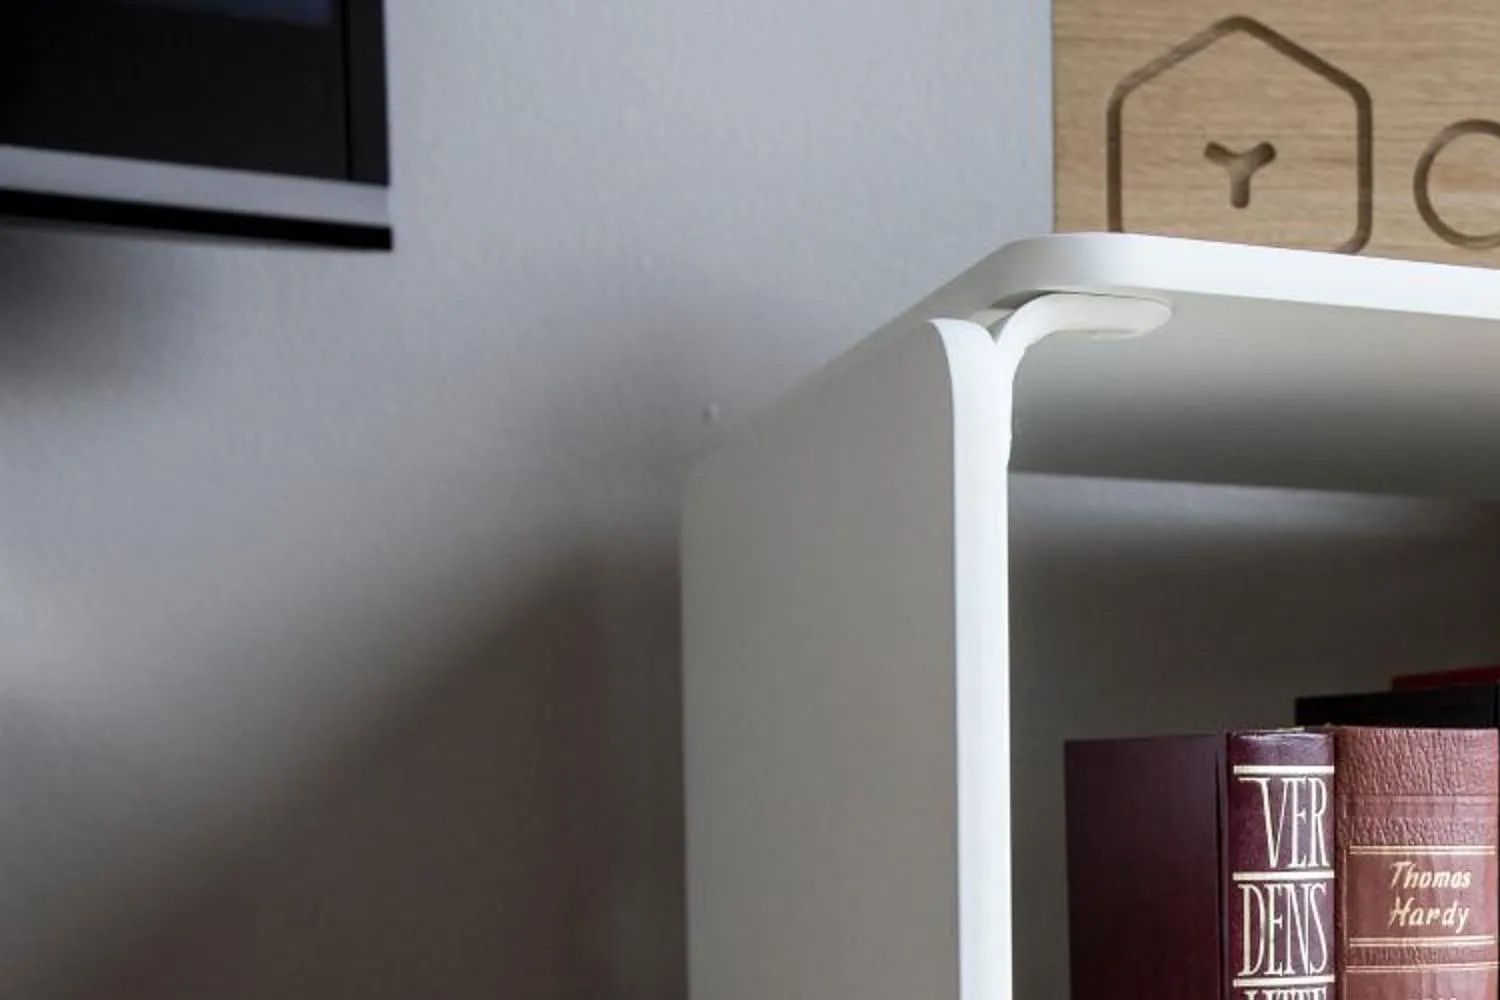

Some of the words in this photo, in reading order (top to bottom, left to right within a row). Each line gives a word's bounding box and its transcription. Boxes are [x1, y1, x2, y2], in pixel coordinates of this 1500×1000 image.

[1238, 776, 1330, 869] VER
[1390, 861, 1473, 889] Thomas
[1237, 882, 1328, 977] DENS
[1388, 897, 1470, 934] Hardy
